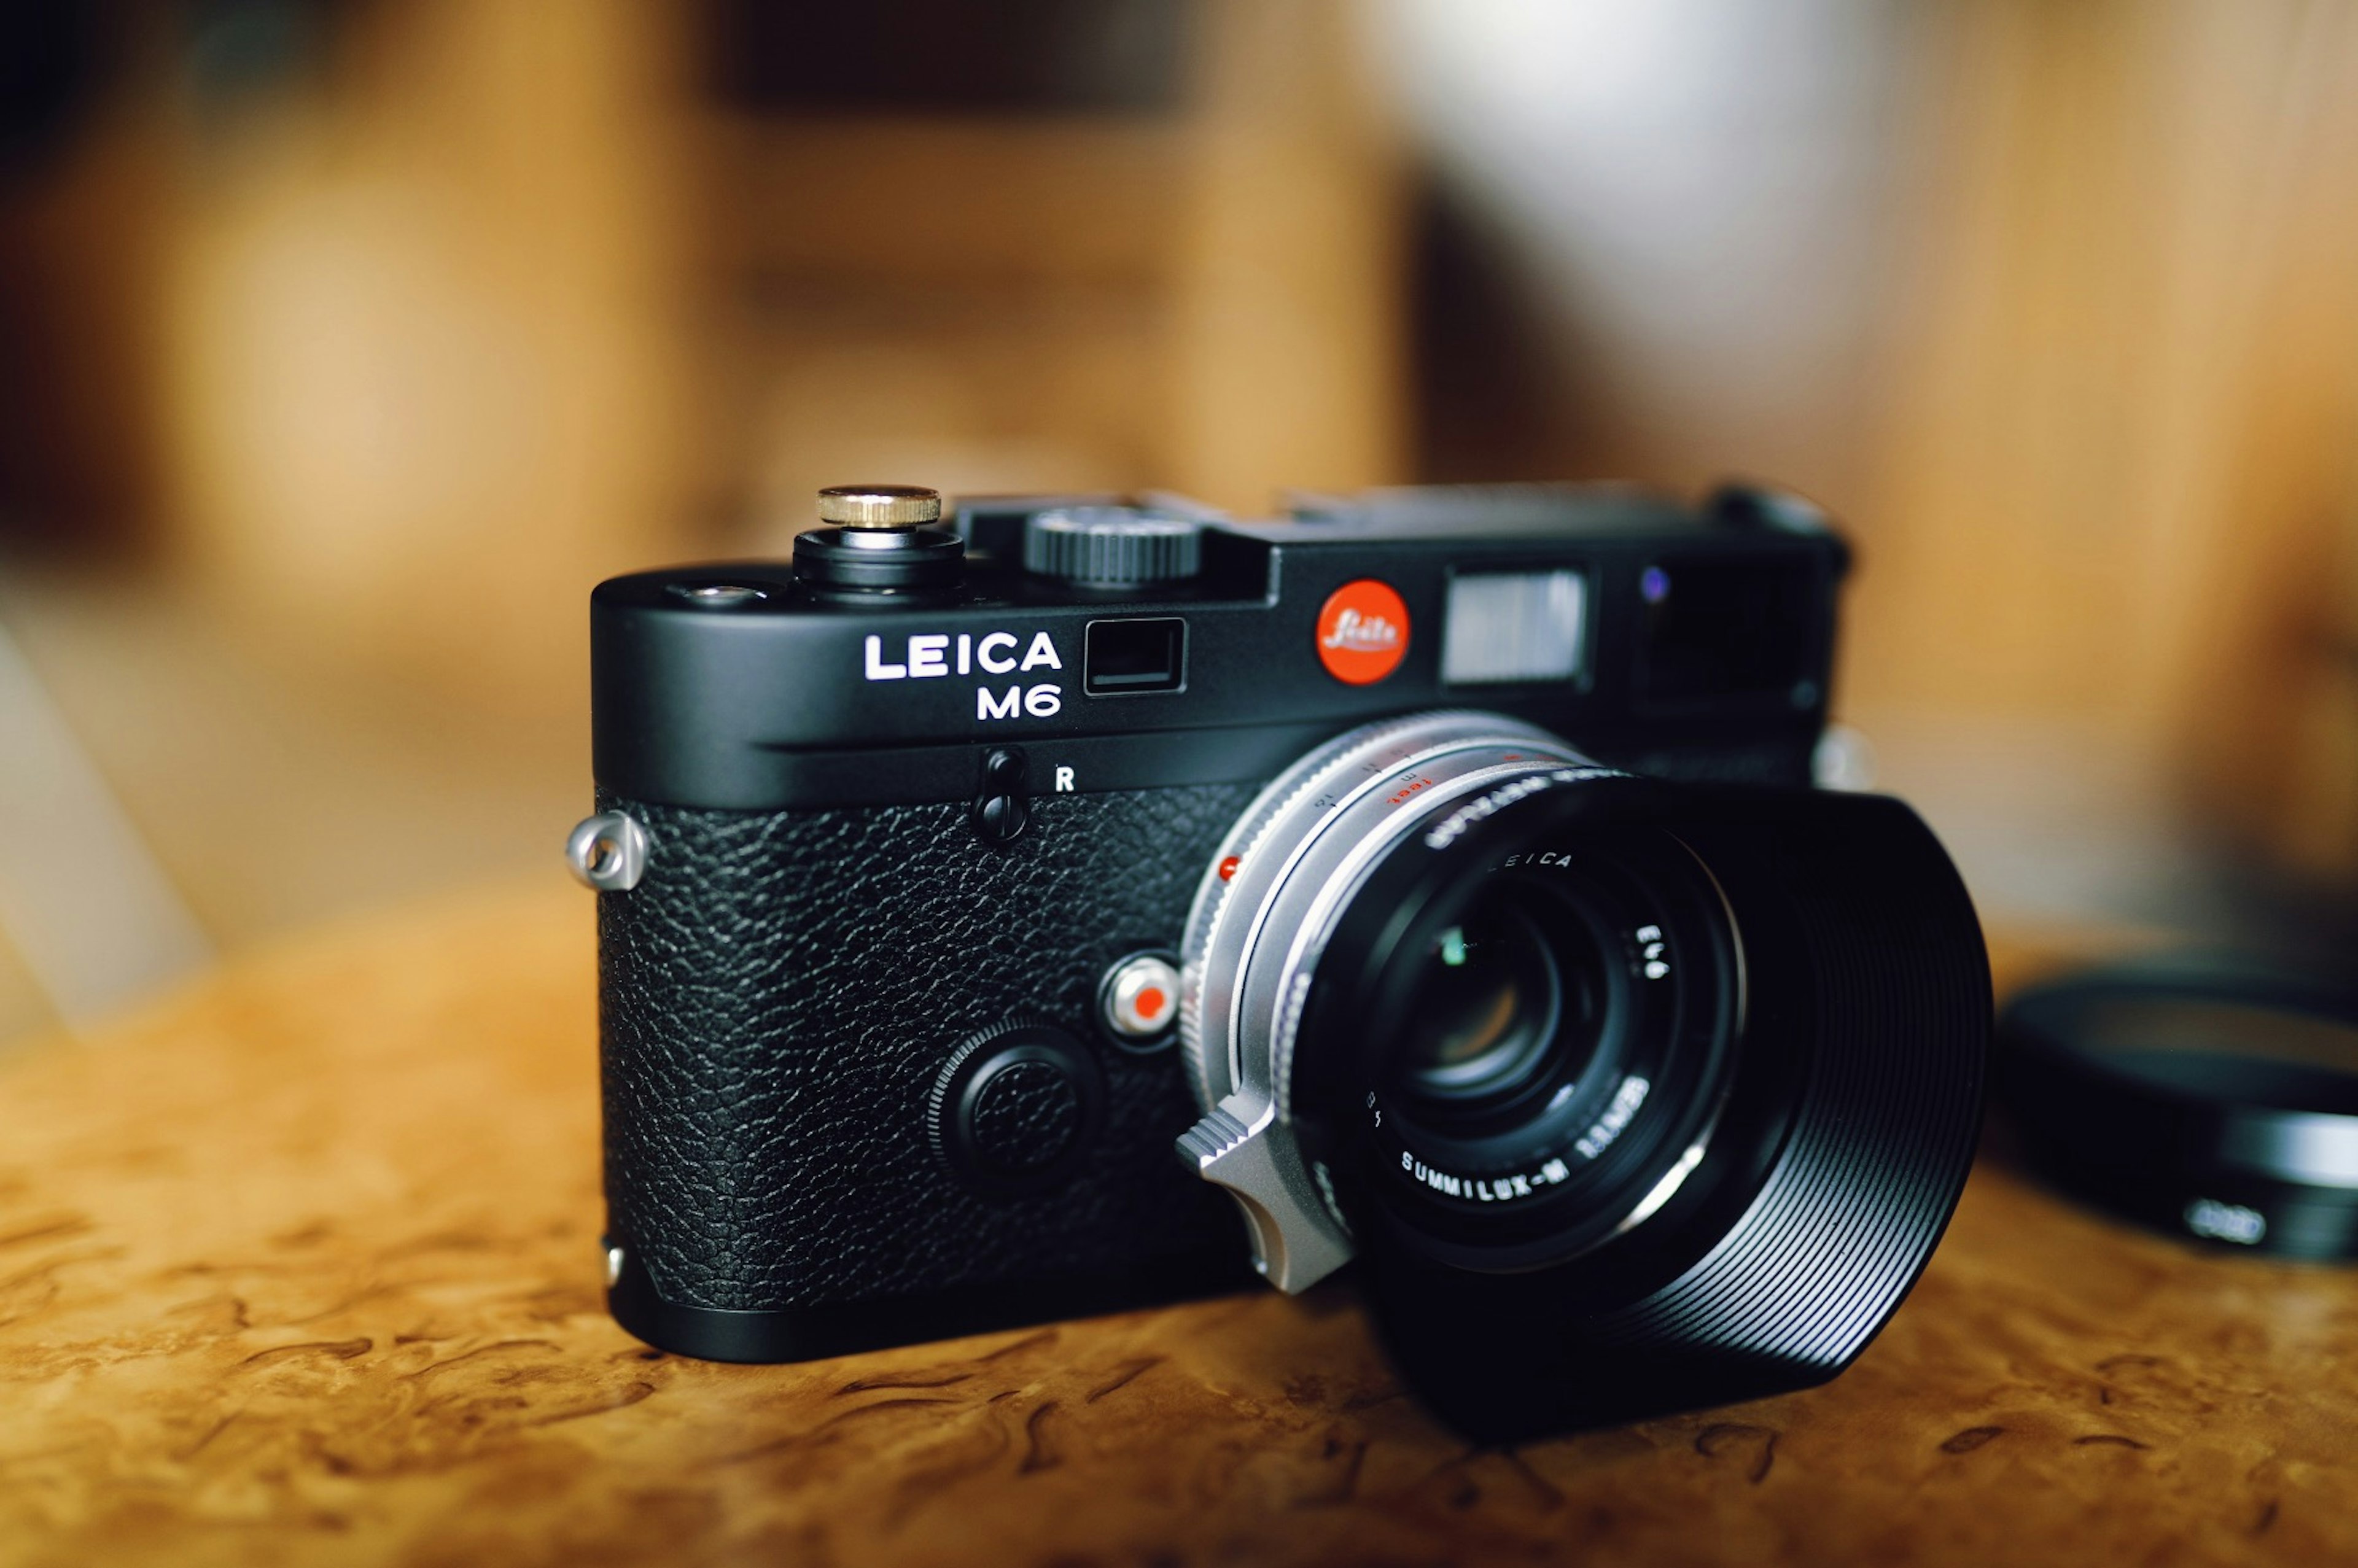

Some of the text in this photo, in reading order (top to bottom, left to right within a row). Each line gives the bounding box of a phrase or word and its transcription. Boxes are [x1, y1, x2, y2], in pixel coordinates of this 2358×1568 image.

[865, 631, 1062, 681] LEICA
[977, 684, 1061, 720] M6
[1056, 766, 1075, 792] R
